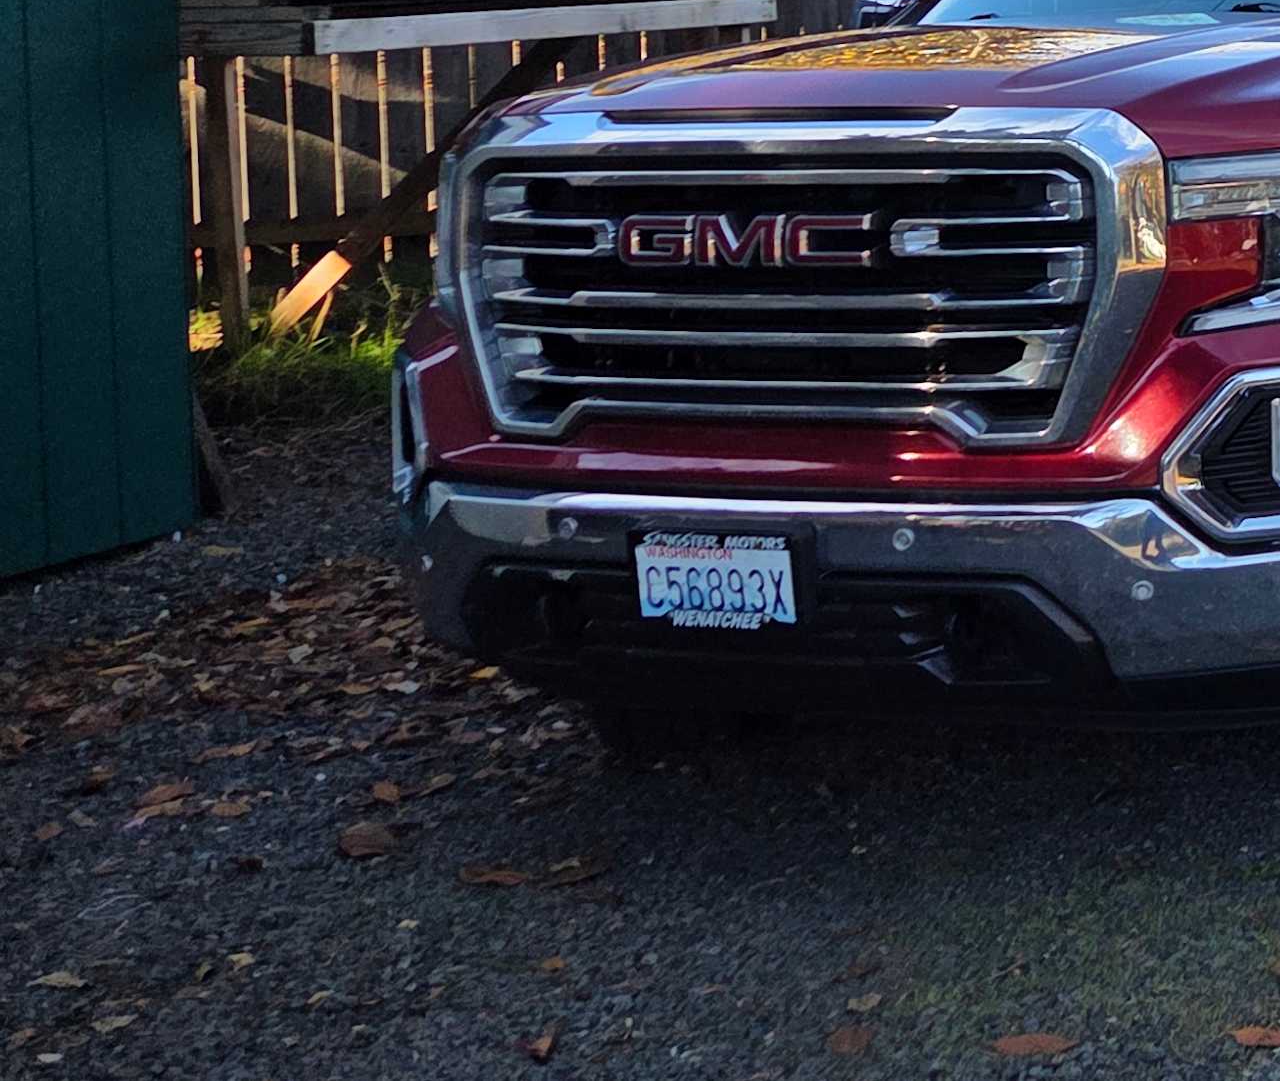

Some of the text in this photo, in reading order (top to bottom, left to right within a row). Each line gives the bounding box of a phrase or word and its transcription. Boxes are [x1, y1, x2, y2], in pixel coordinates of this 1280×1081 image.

[618, 214, 873, 267] GMC
[645, 546, 733, 560] WASHINGTON
[724, 535, 786, 550] MOTORS
[645, 566, 788, 616] C56893X
